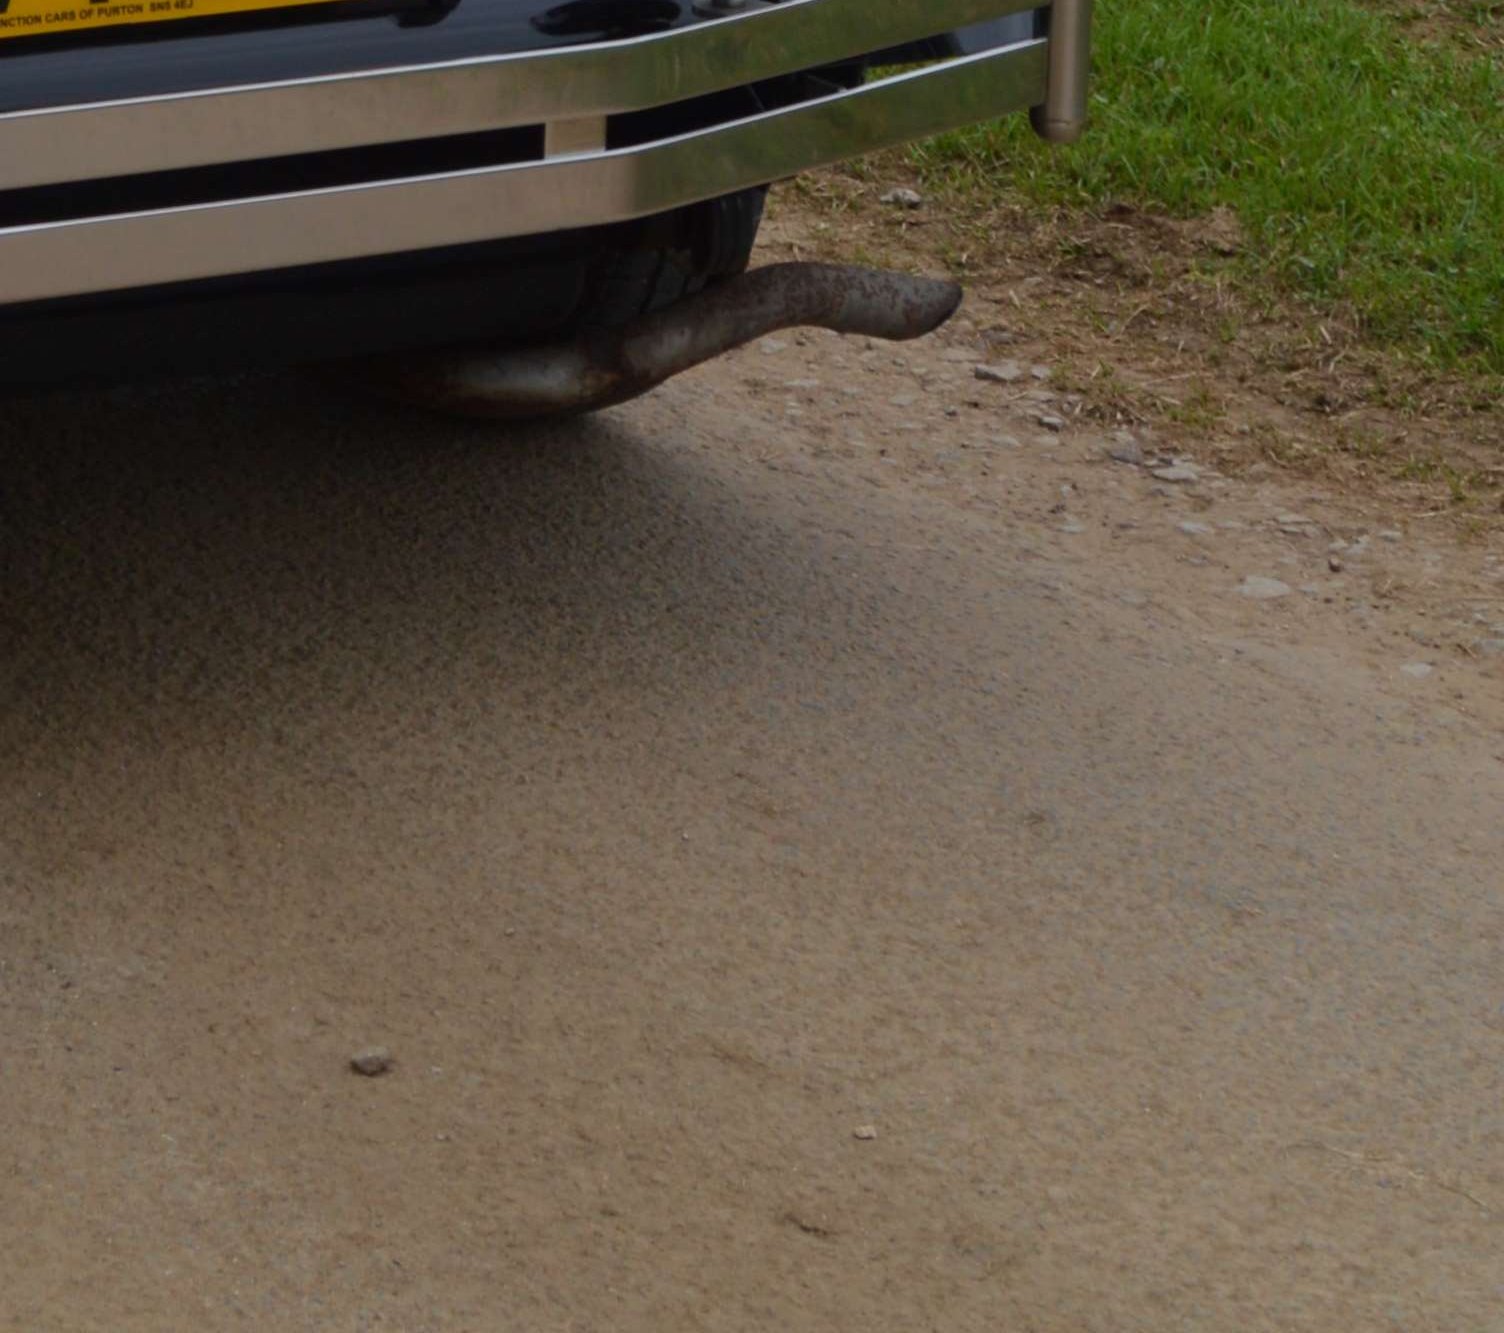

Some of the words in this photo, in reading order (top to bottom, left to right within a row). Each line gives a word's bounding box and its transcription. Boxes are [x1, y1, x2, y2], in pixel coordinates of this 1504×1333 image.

[45, 9, 76, 23] CARS
[79, 8, 93, 20] OF
[97, 3, 143, 18] PURTON
